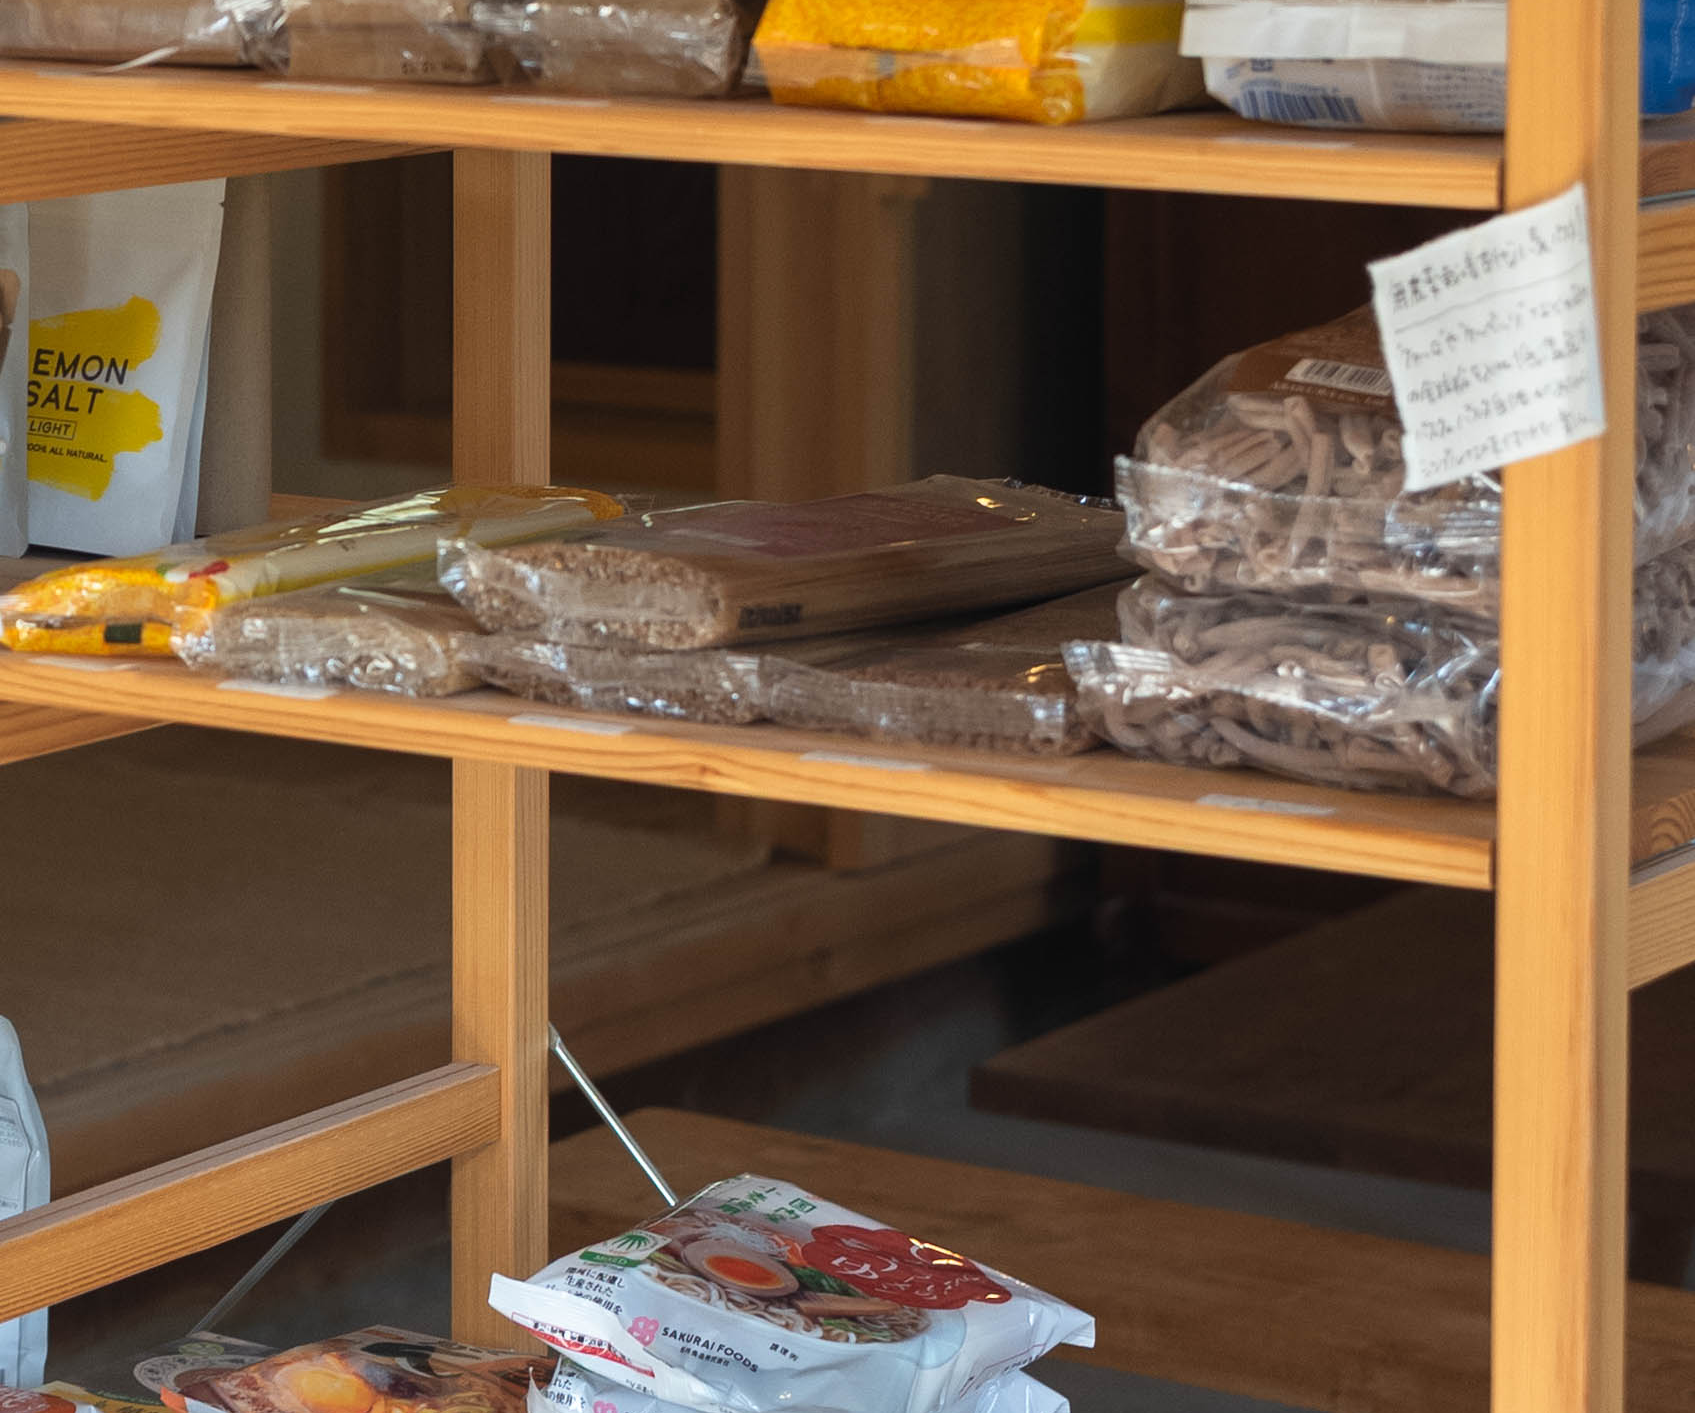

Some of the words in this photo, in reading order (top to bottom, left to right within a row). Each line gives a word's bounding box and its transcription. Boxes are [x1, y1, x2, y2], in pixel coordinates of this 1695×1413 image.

[26, 379, 104, 414] SALT
[29, 420, 72, 436] LIGHT
[49, 447, 64, 456] ALL
[662, 1326, 717, 1352] SAKURAI
[717, 1343, 759, 1374] FOODS
